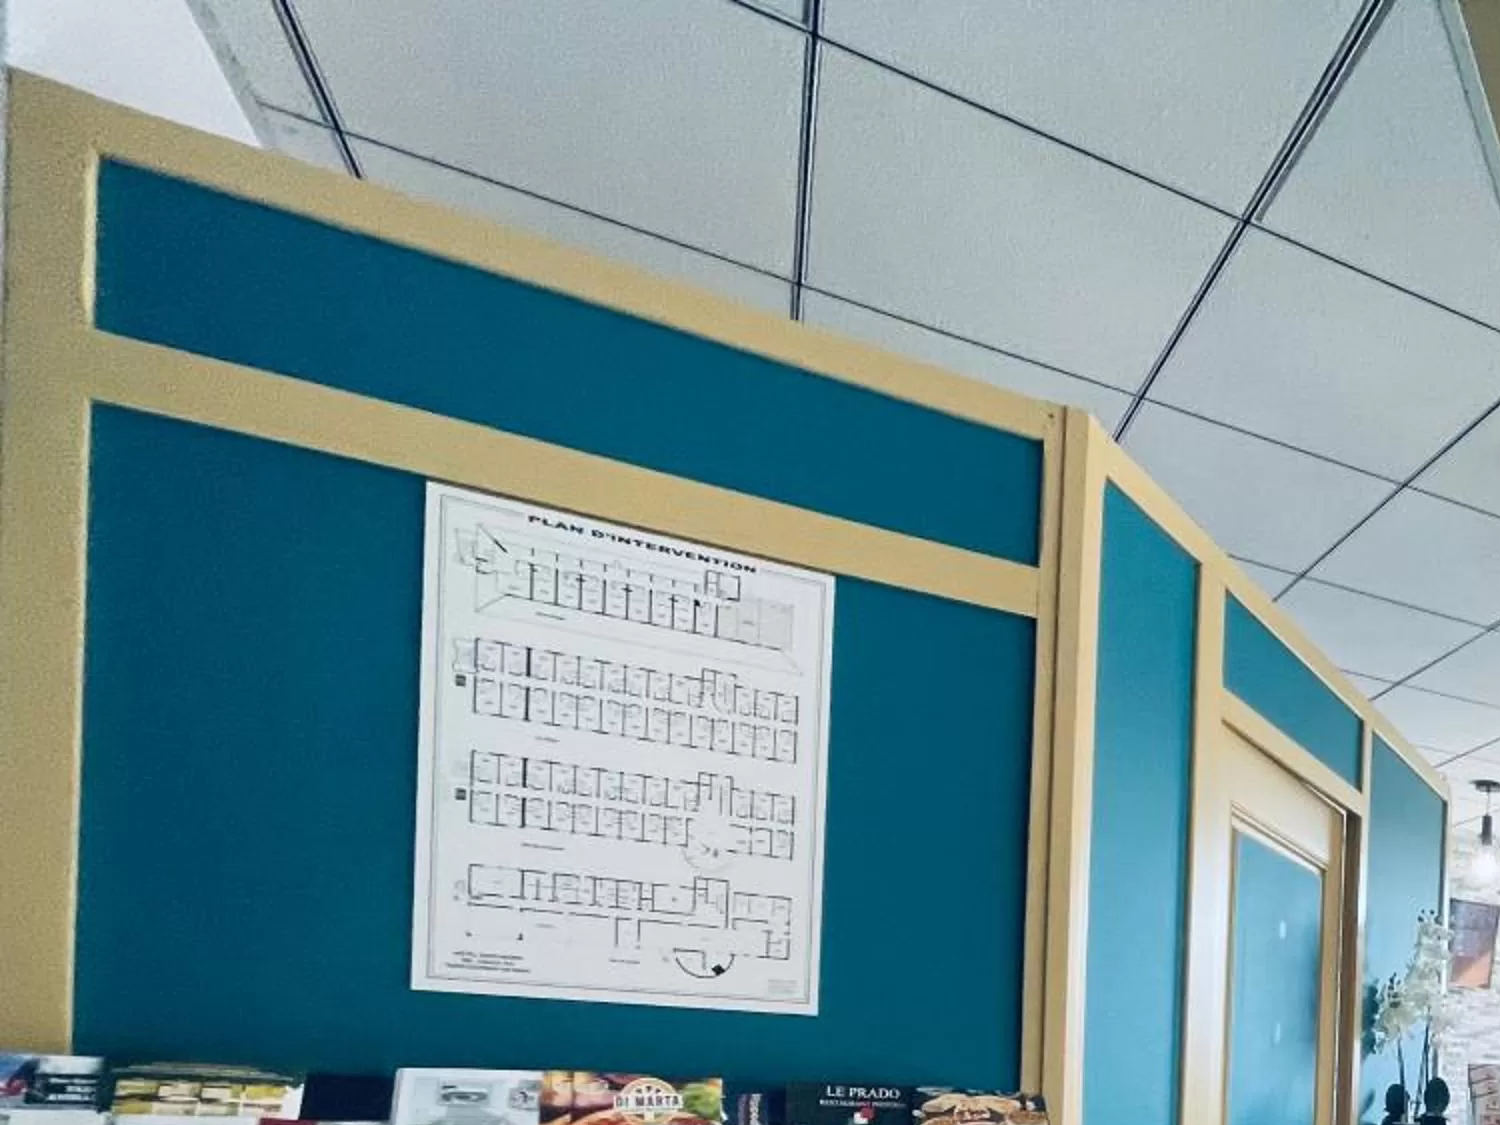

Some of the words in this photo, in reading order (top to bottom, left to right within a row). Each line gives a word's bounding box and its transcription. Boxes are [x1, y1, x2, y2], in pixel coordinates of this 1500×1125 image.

[528, 514, 585, 536] PLAN
[590, 528, 758, 574] D'INTERVENTION
[826, 1085, 845, 1098] LE
[848, 1087, 902, 1100] PRADO
[634, 1095, 682, 1109] MARTA
